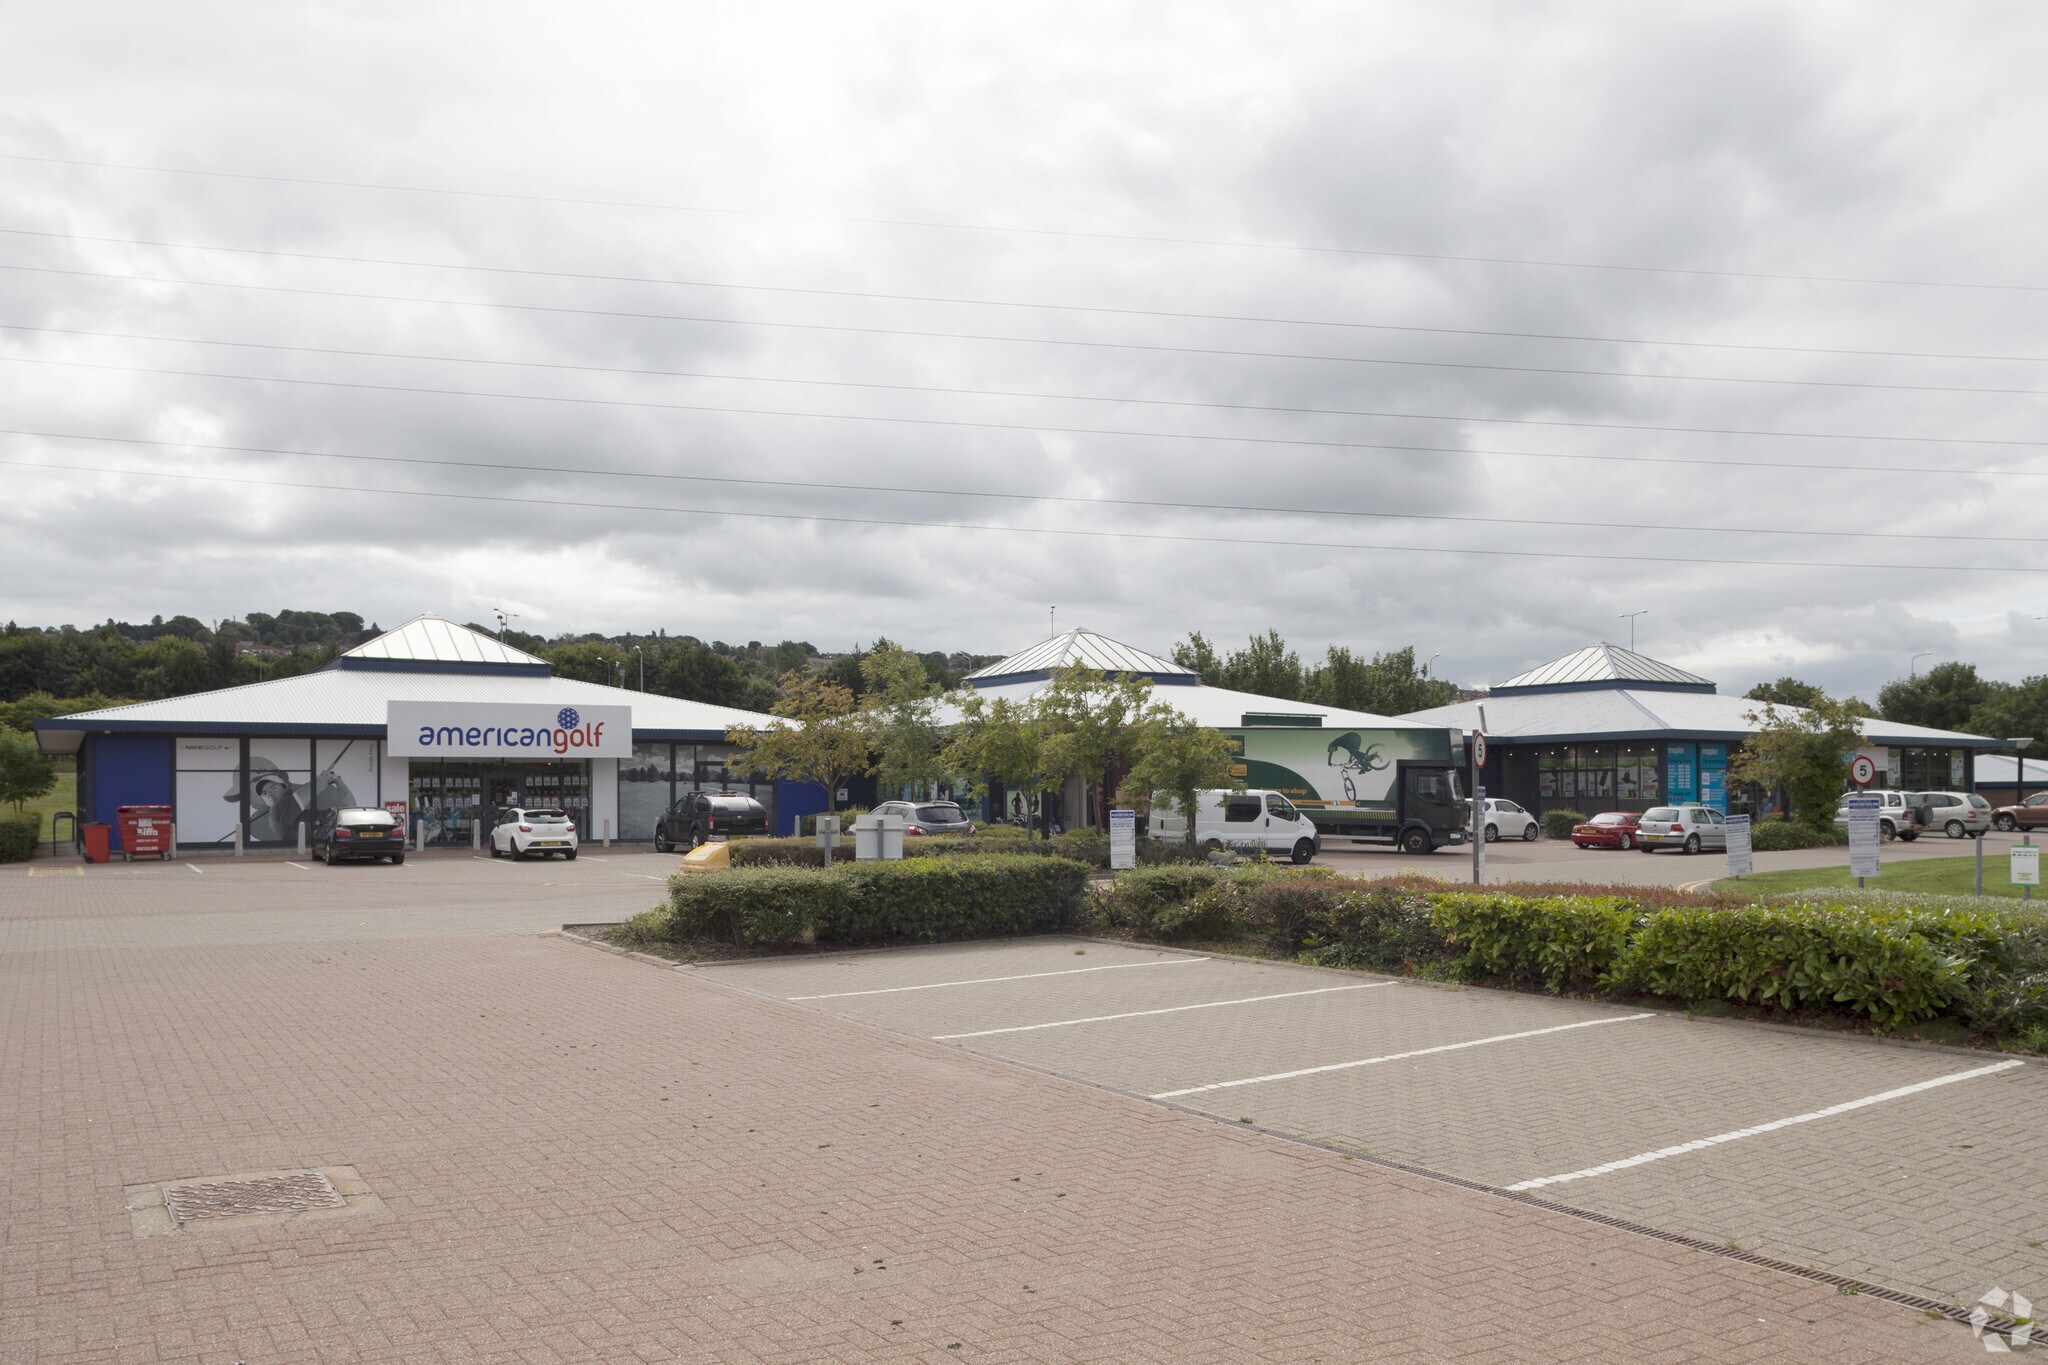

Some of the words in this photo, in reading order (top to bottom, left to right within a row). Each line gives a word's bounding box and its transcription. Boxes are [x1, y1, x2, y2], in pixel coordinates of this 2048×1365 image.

[418, 721, 605, 754] americangolf
[1478, 743, 1483, 758] 5
[1859, 765, 1867, 776] 5
[386, 803, 405, 813] sale
